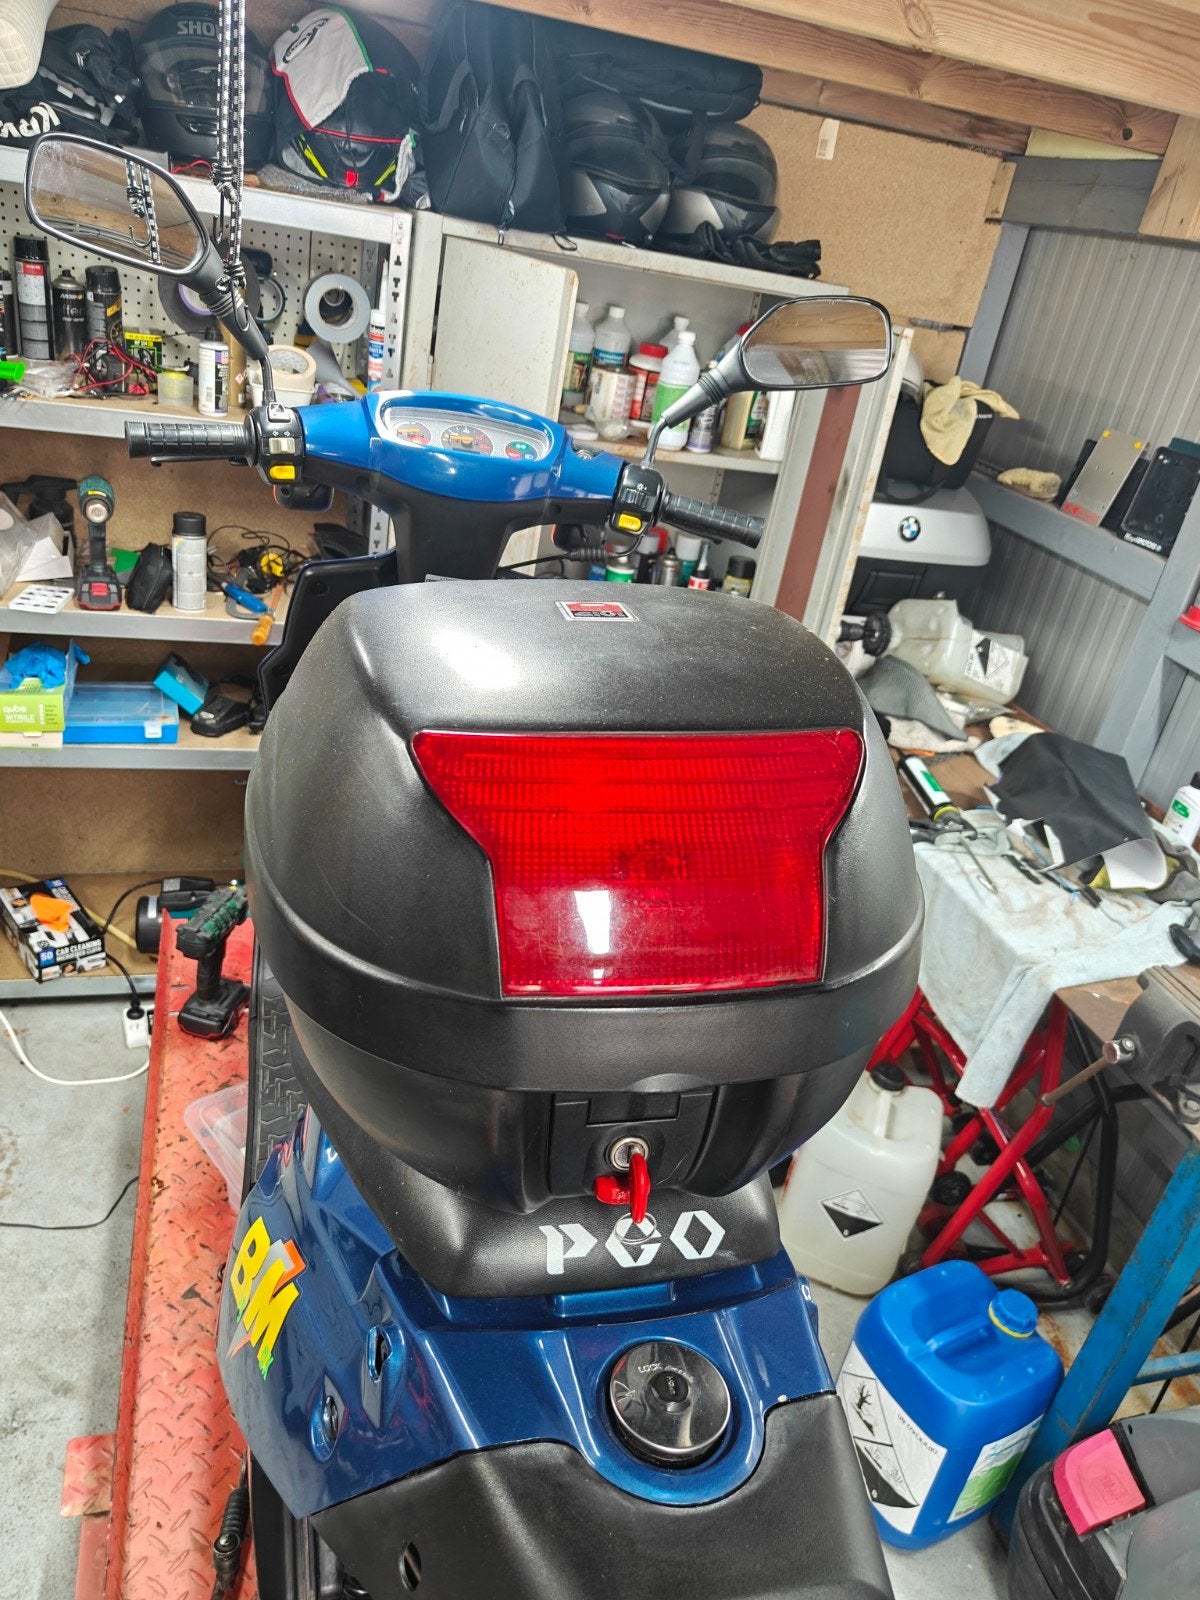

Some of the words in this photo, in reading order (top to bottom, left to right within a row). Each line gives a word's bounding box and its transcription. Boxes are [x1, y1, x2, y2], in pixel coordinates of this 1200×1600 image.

[41, 950, 54, 961] 50
[56, 947, 70, 956] CAR
[538, 1209, 727, 1275] PGO
[637, 1362, 664, 1374] LOCK
